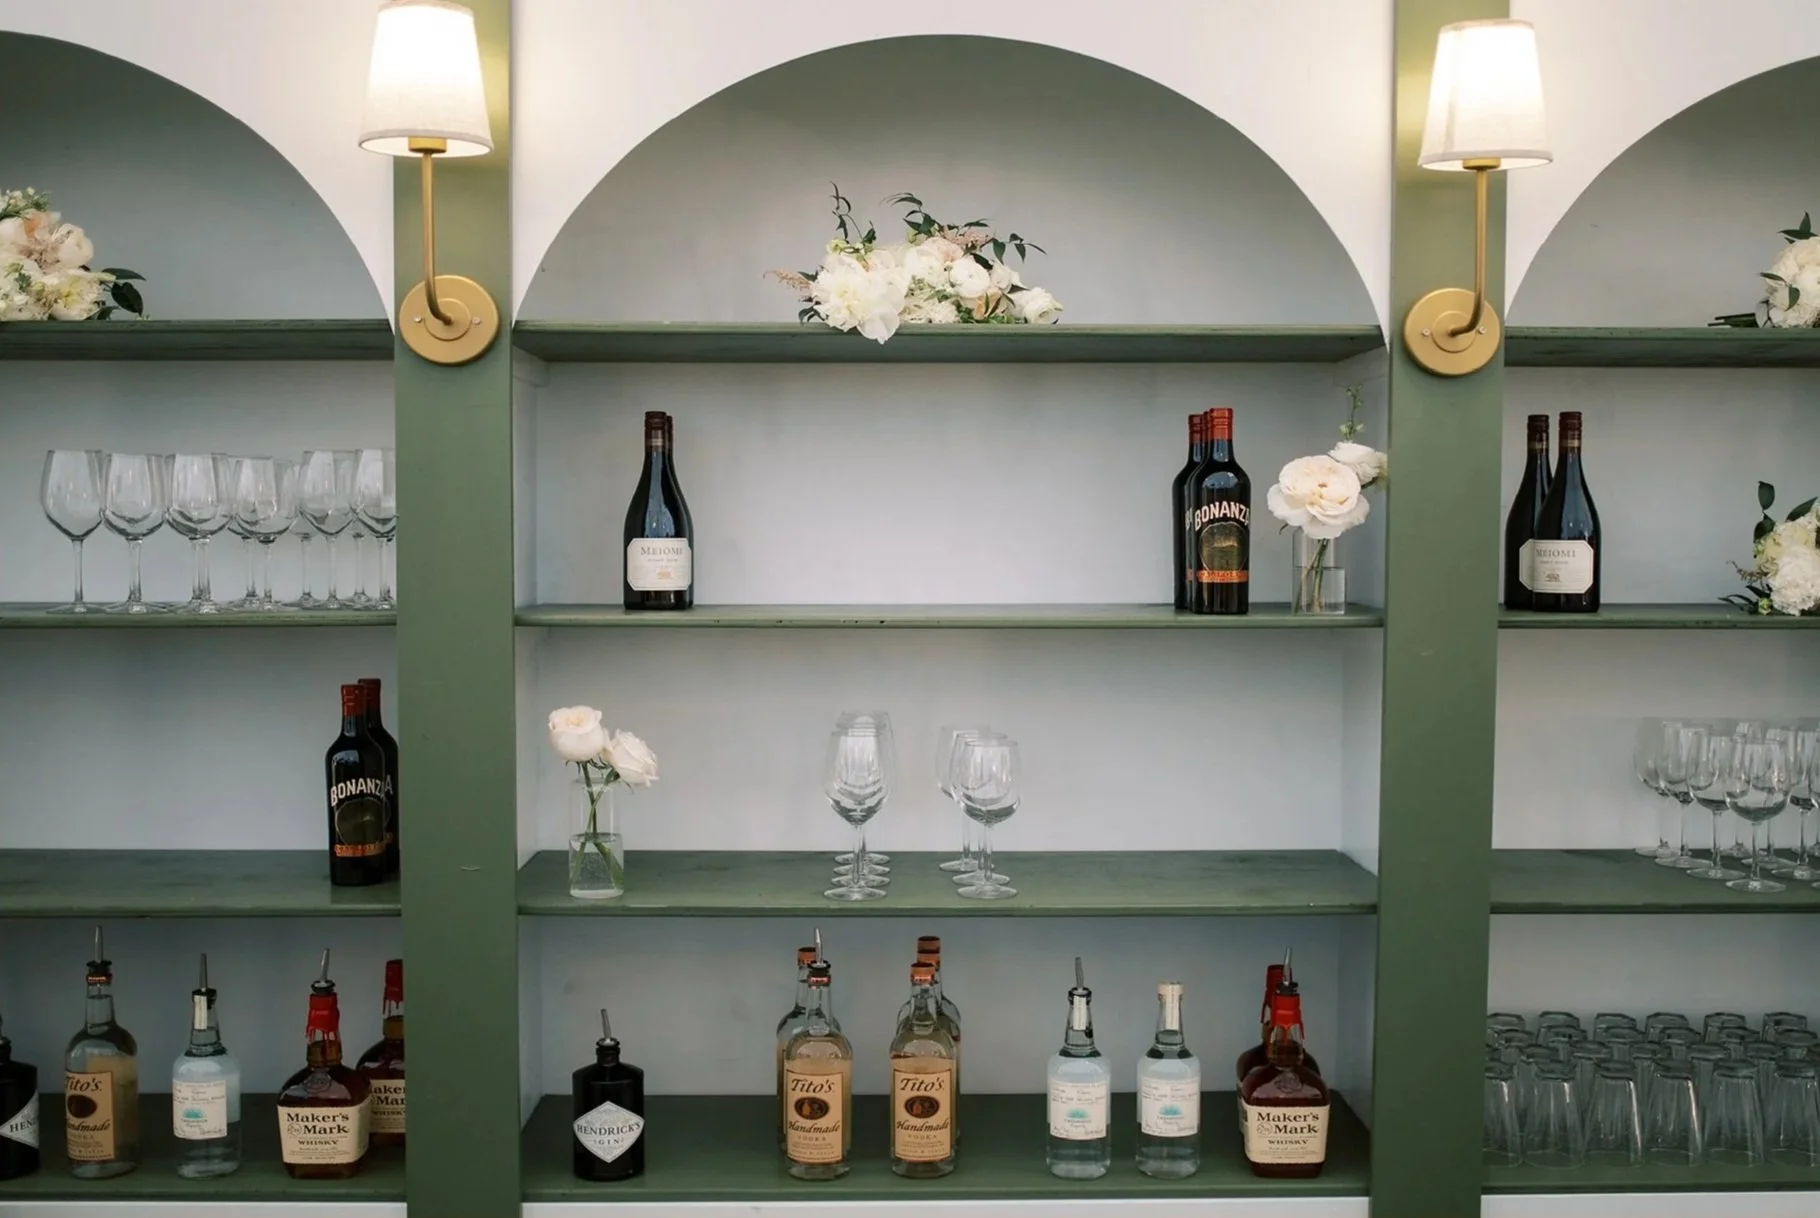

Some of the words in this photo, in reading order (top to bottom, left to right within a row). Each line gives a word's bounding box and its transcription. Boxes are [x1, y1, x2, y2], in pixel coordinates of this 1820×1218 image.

[640, 546, 683, 556] MEIOMI
[1535, 548, 1577, 558] MEIOMI
[791, 1077, 835, 1094] Tito's
[900, 1076, 945, 1093] Tito's
[286, 1112, 350, 1123] Maker's
[1256, 1111, 1320, 1123] Maker's
[302, 1123, 349, 1135] Mark
[788, 1120, 841, 1134] Handmade
[895, 1116, 950, 1133] Handmade
[1274, 1123, 1319, 1135] Mark
